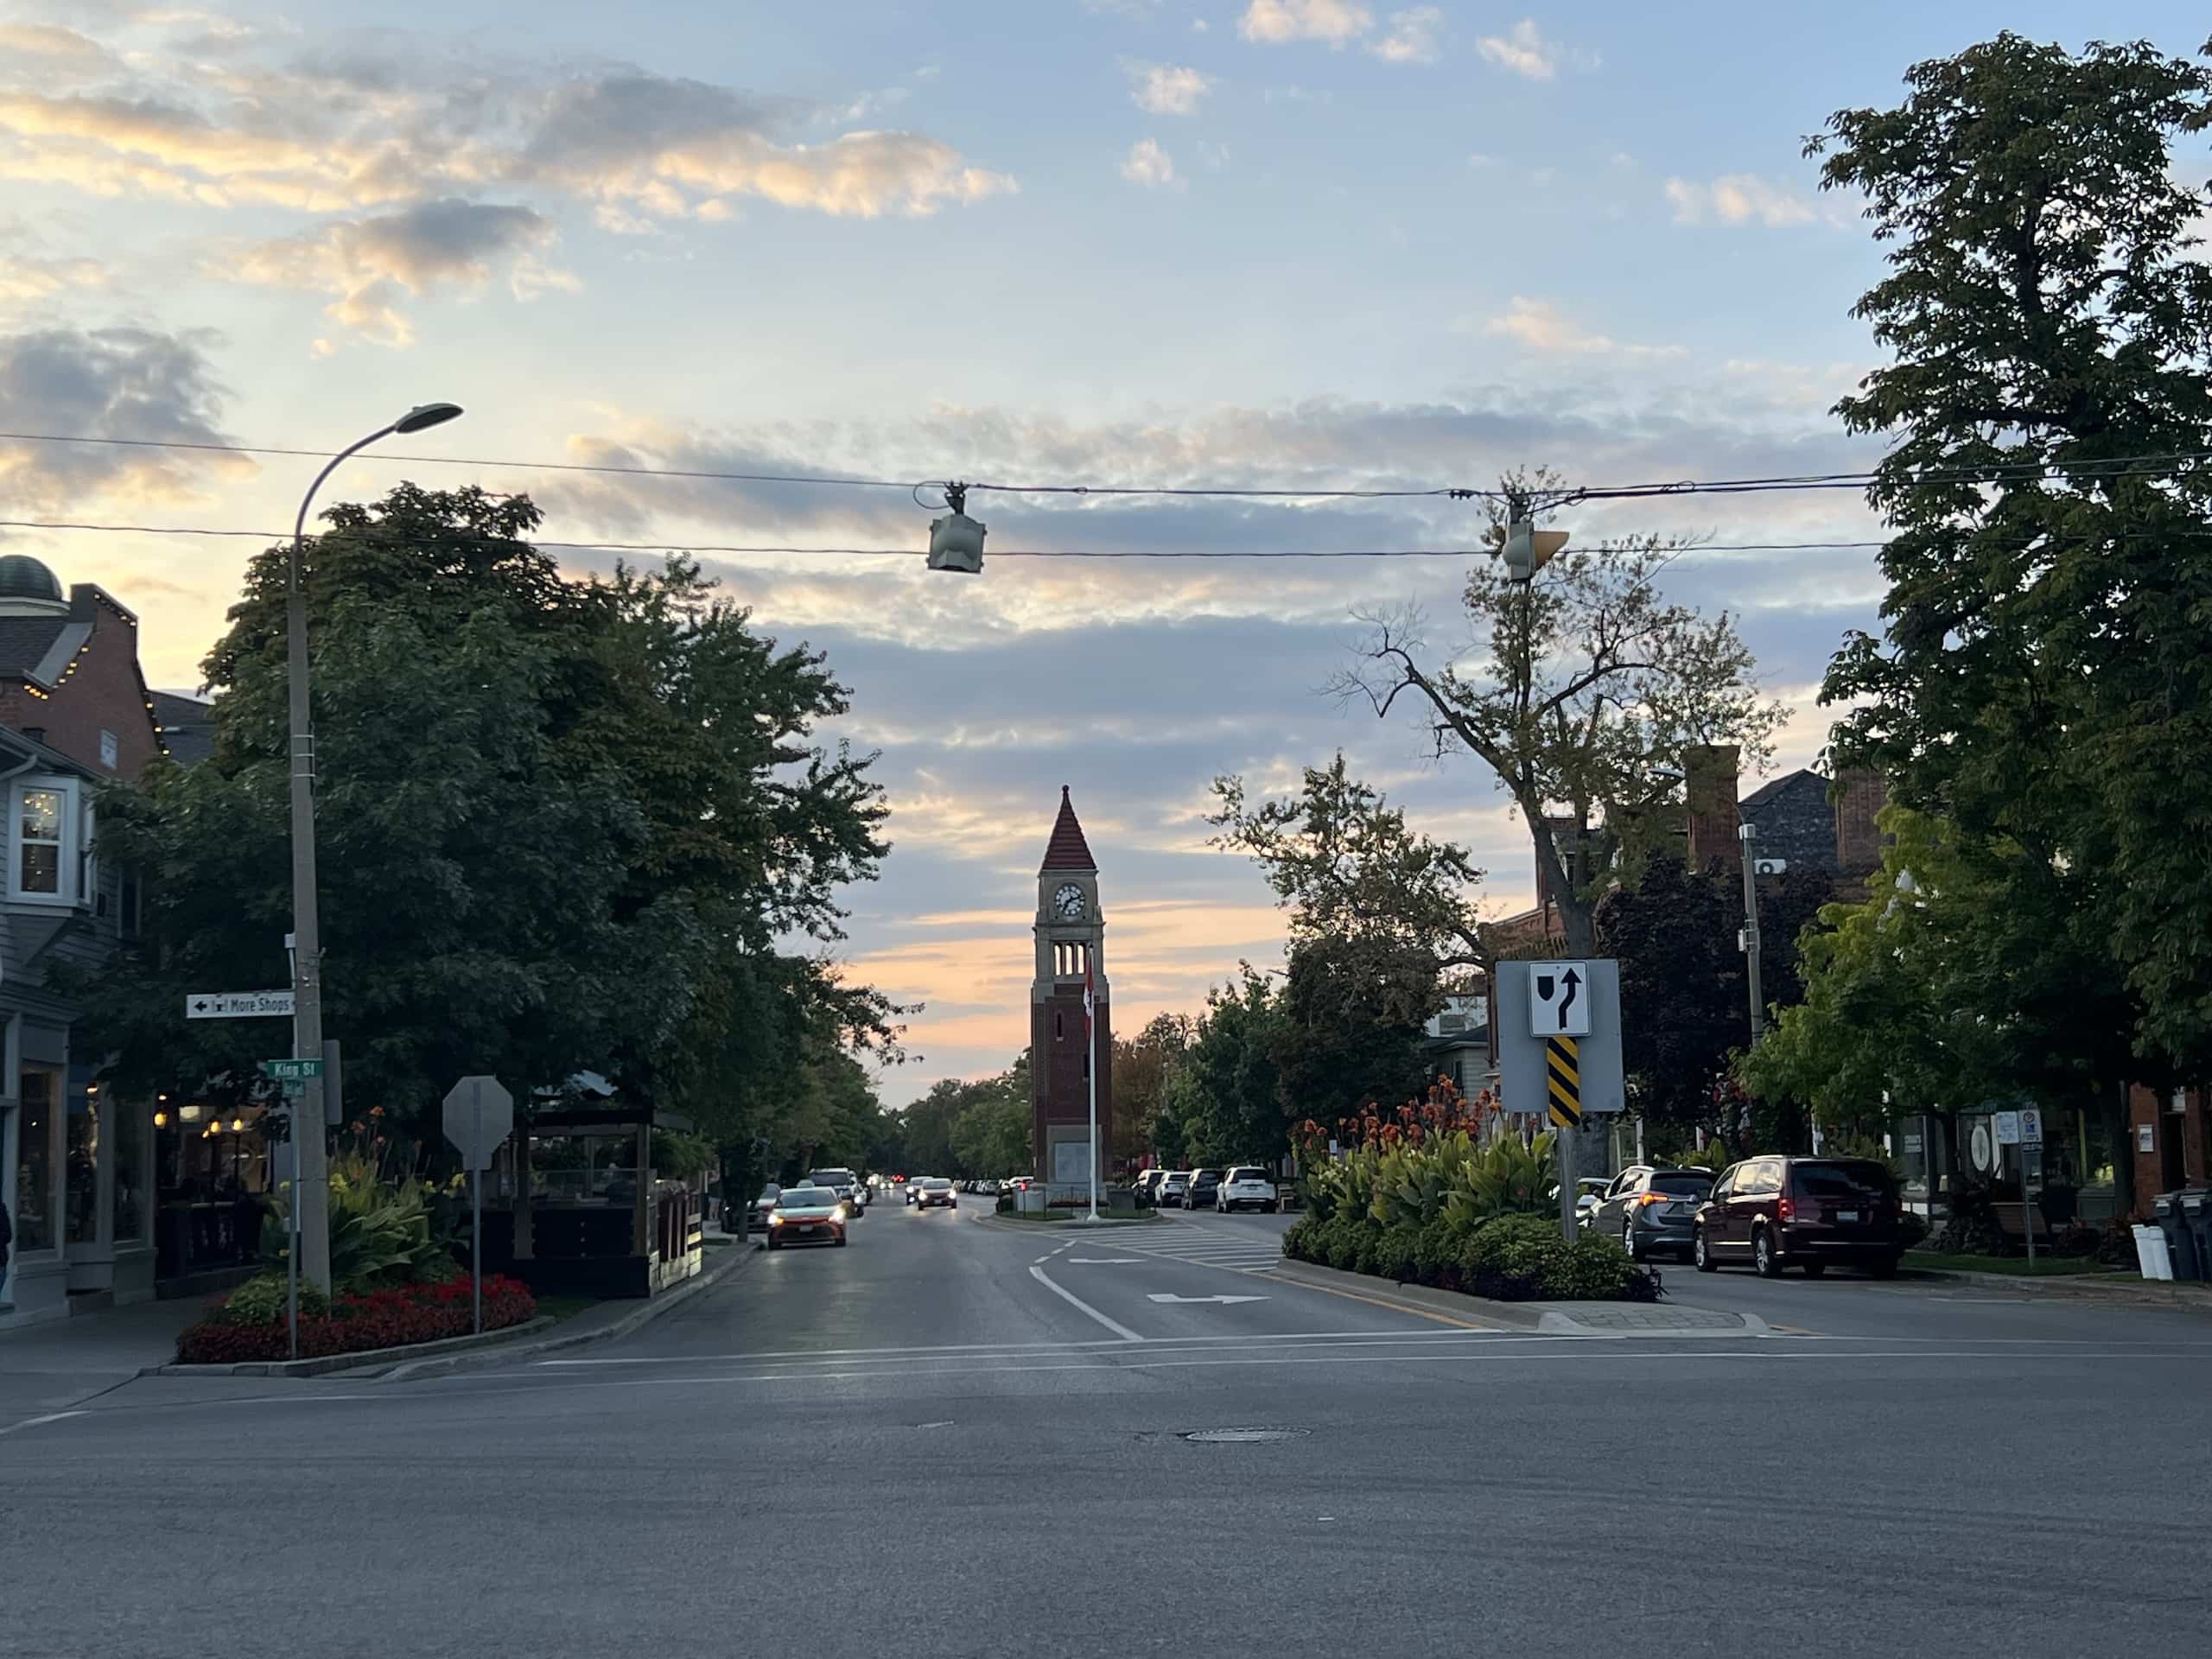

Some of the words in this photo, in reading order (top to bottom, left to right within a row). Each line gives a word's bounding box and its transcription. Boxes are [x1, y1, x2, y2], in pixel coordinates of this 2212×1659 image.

[231, 999, 256, 1013] More
[258, 997, 289, 1014] Shops
[275, 1063, 299, 1078] King
[303, 1062, 315, 1077] St
